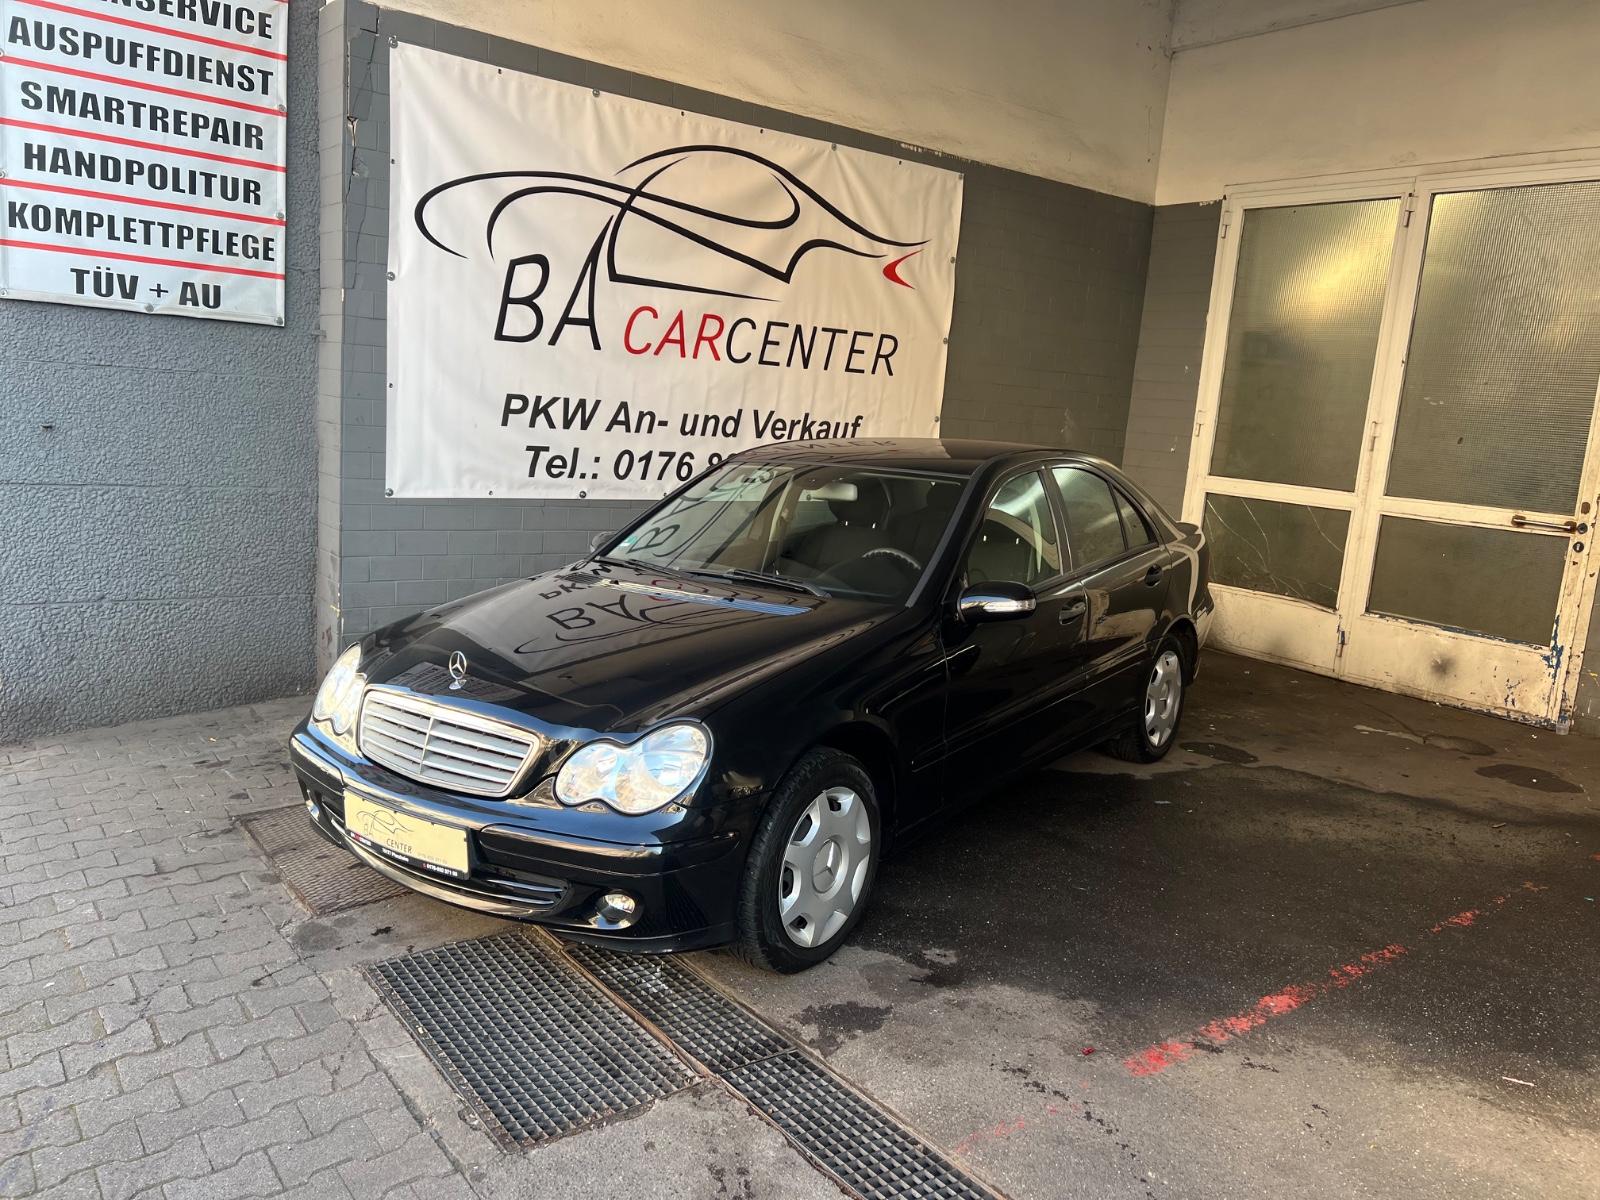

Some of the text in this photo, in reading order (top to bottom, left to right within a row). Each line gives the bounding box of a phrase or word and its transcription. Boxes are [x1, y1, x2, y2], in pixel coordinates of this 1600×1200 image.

[8, 15, 274, 96] AUSPUFFDIENST
[20, 80, 264, 151] SMARTREPAIR
[24, 142, 262, 206] HANDPOLITUR
[8, 201, 276, 262] KOMPLETTPFLEGE
[70, 266, 222, 309] TÜV + AU
[494, 215, 899, 377] BA CARCENTER
[501, 393, 865, 441] PKW An- und Verkauf
[525, 445, 601, 480] Tel.:
[613, 449, 696, 482] 0176
[386, 838, 413, 854] CENTER
